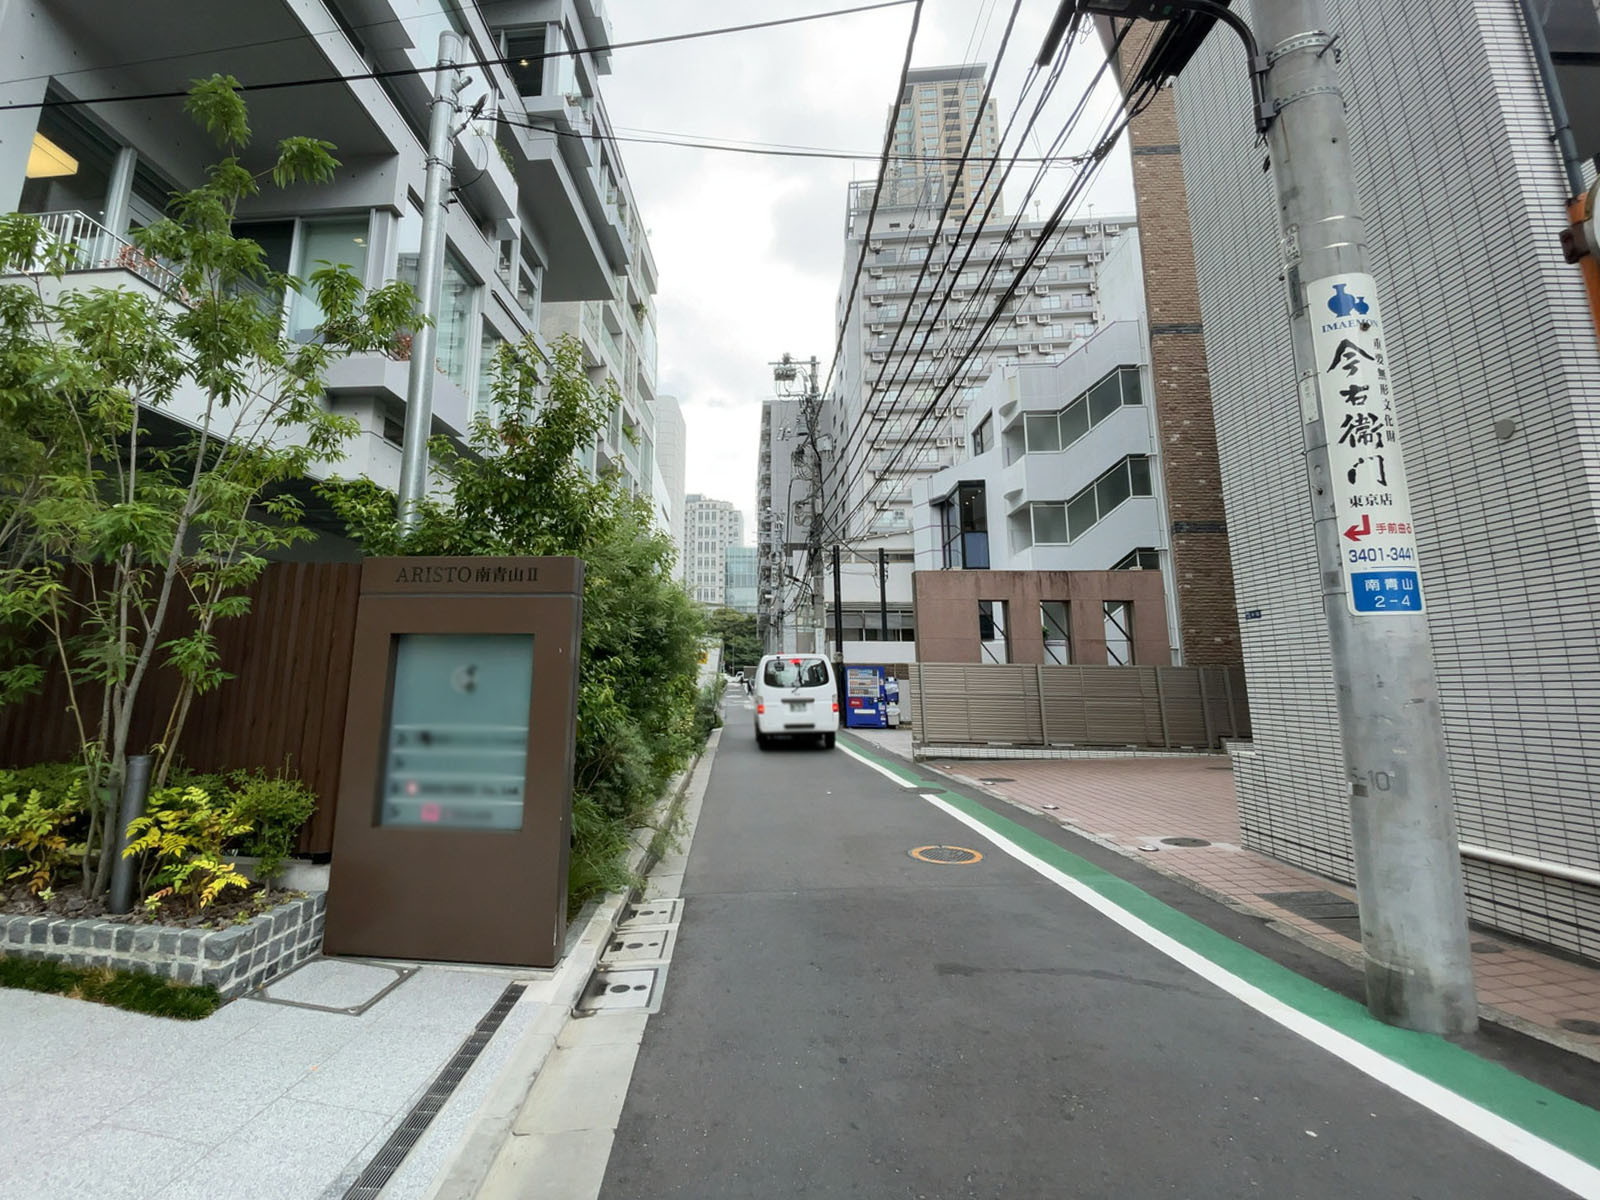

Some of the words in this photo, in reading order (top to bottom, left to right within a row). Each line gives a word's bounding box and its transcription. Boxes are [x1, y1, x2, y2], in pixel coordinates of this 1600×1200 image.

[1349, 492, 1393, 508] 東京店
[1375, 522, 1413, 535] 手前曲る
[1348, 546, 1416, 564] 3401-3441
[1364, 577, 1414, 592] 南青山
[1374, 594, 1411, 608] 2-4
